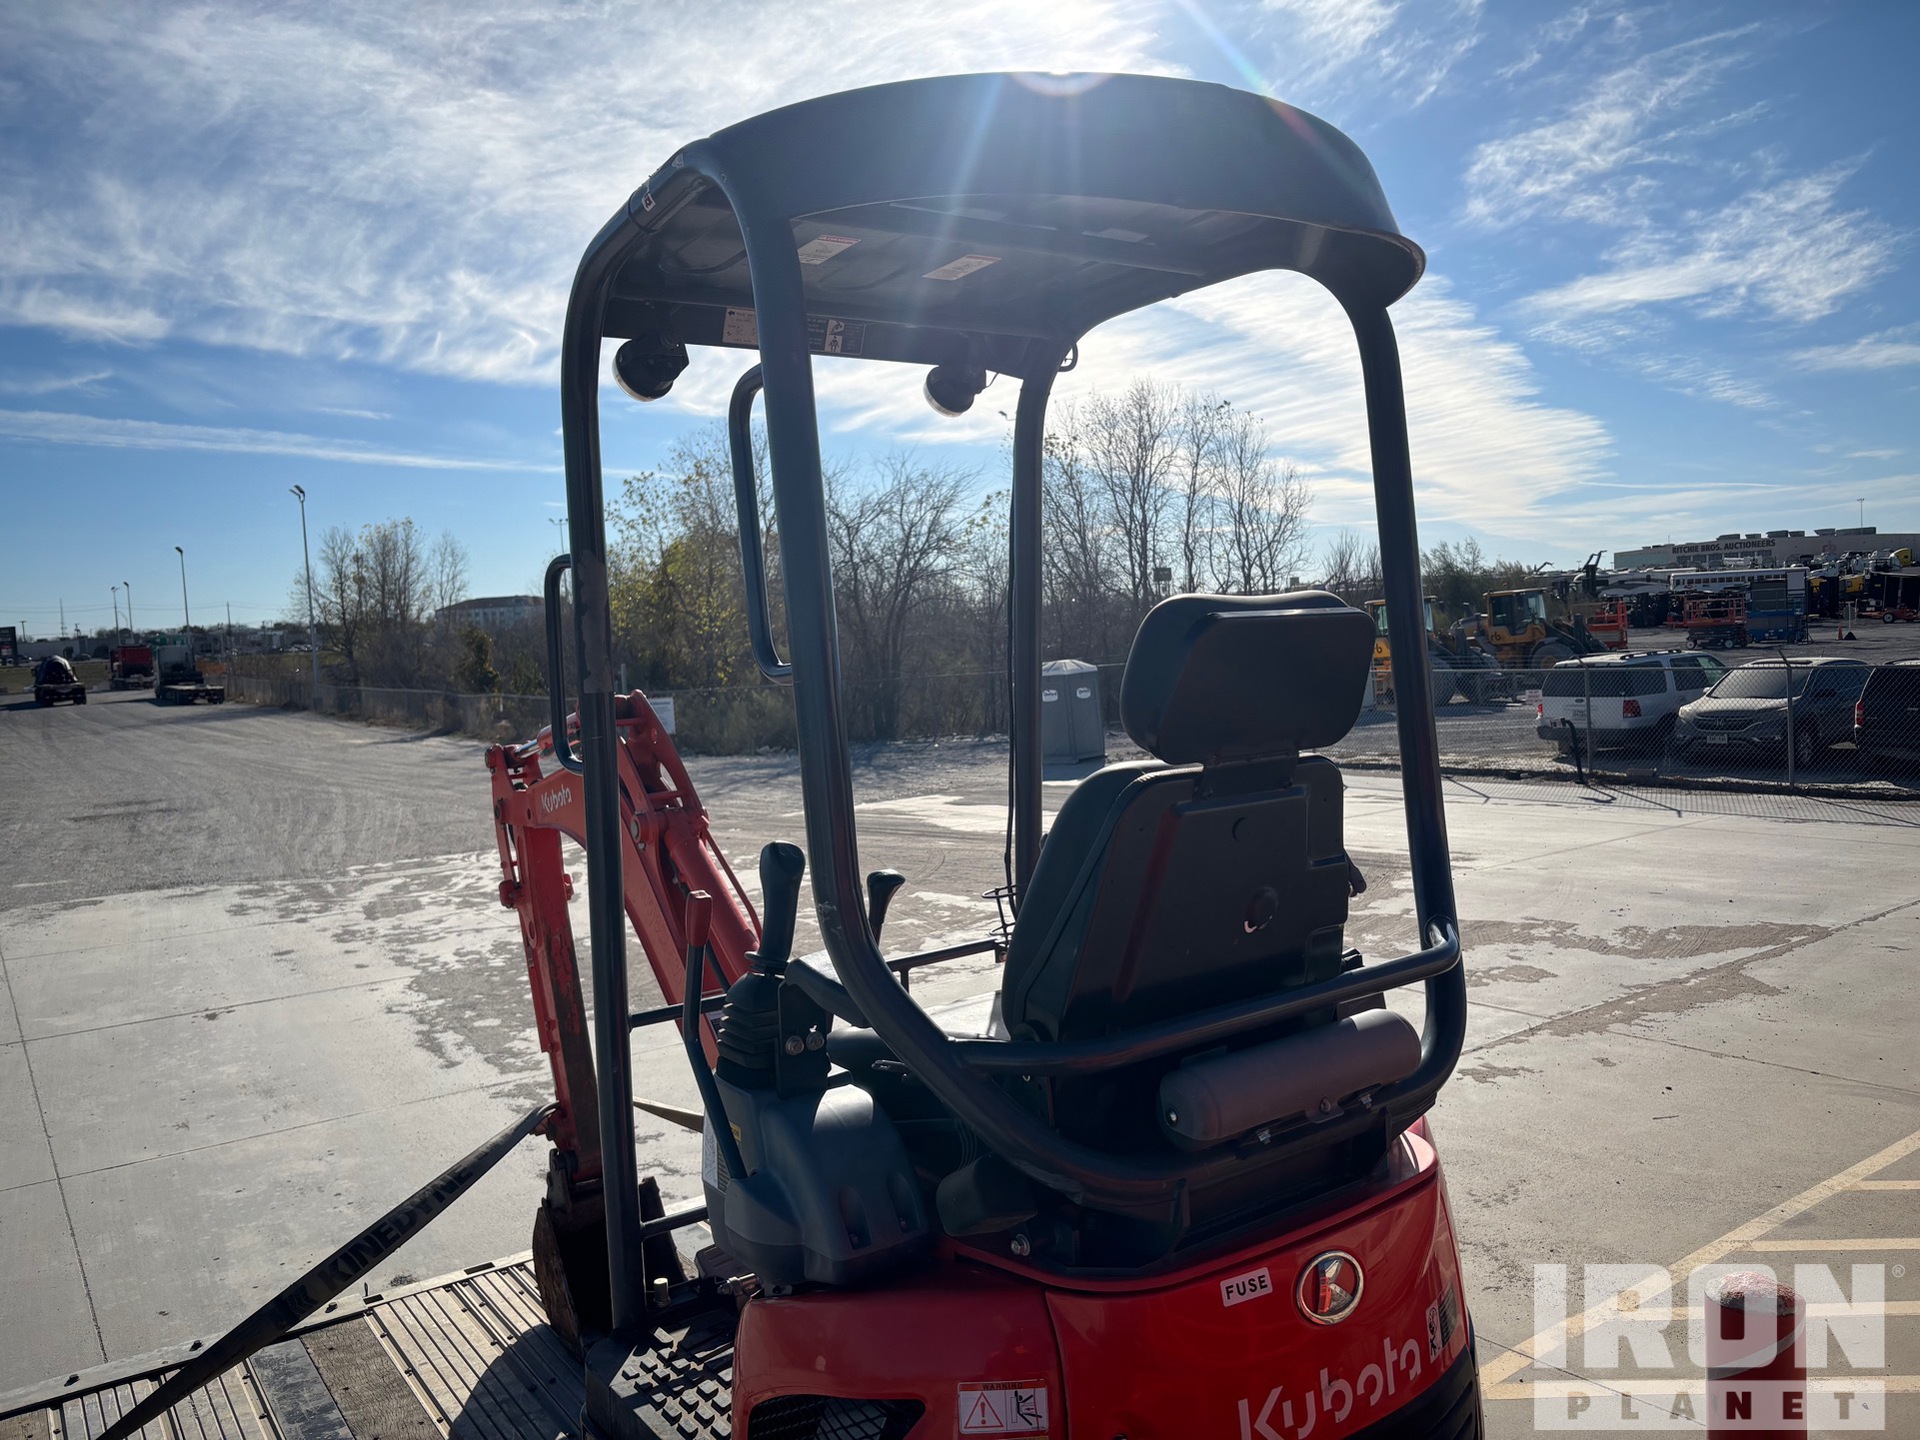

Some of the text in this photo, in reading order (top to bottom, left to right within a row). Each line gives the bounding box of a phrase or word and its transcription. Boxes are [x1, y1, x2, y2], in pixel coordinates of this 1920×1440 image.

[1672, 539, 1776, 554] RITCHIE BROS. AUCTIONEERS
[1490, 632, 1501, 641] rb
[541, 784, 572, 813] Kubota
[316, 1163, 474, 1292] KINEDYNE
[1224, 1274, 1268, 1300] FUSE
[982, 1382, 1024, 1390] WARNING
[1237, 1336, 1422, 1440] Kubota
